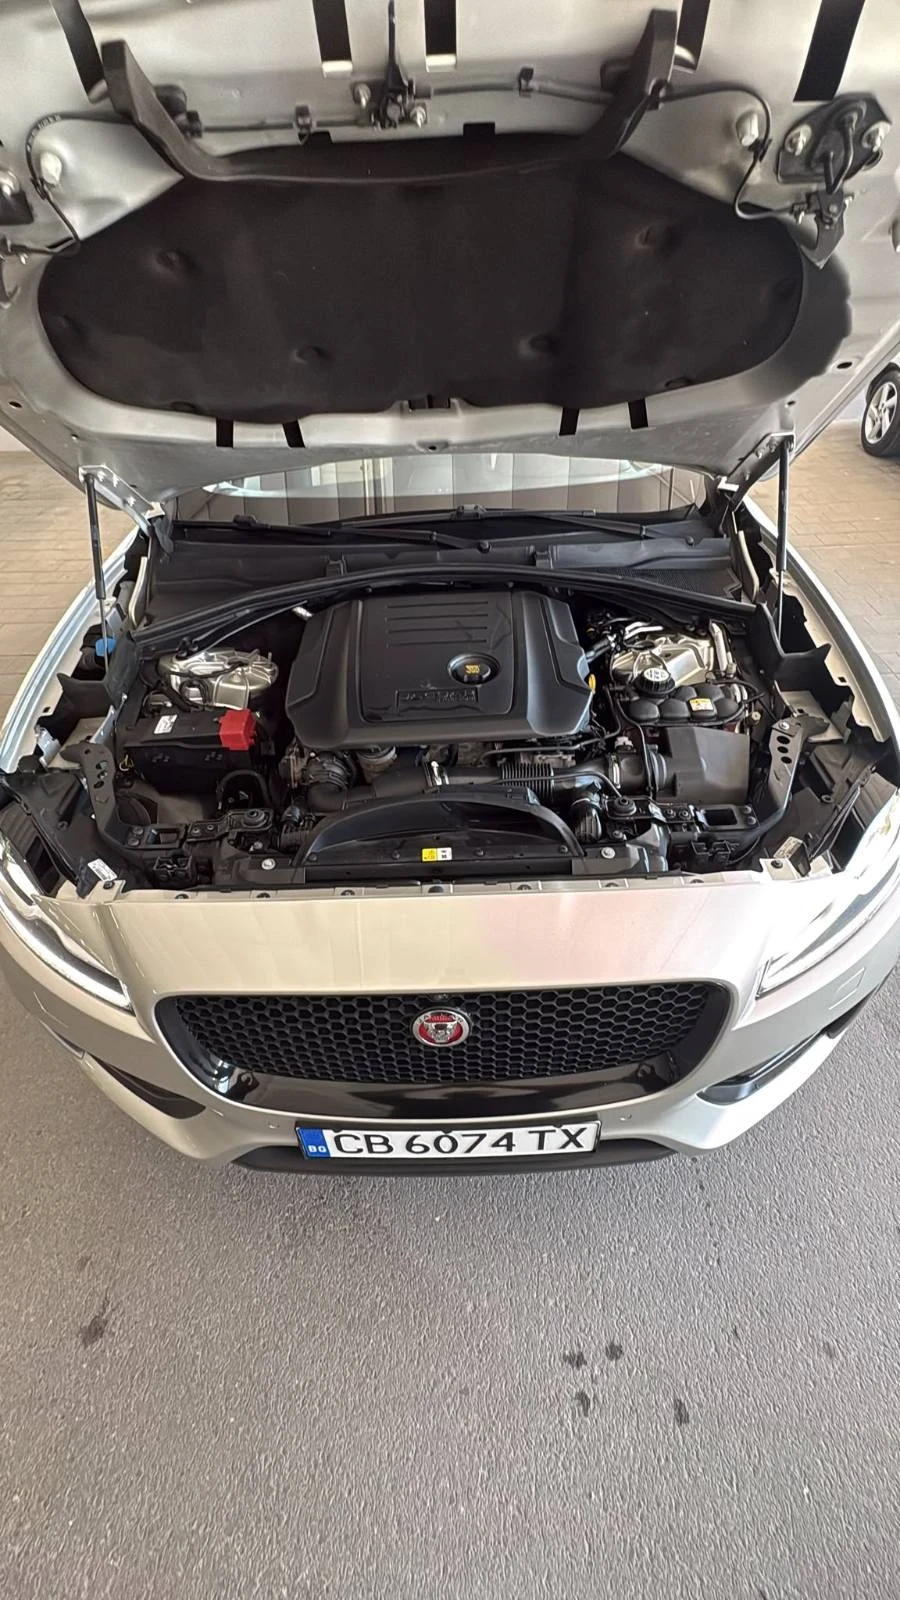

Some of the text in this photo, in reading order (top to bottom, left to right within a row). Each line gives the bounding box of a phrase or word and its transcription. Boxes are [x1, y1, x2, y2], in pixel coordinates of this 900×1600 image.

[333, 1127, 588, 1154] CB 6074 TX
